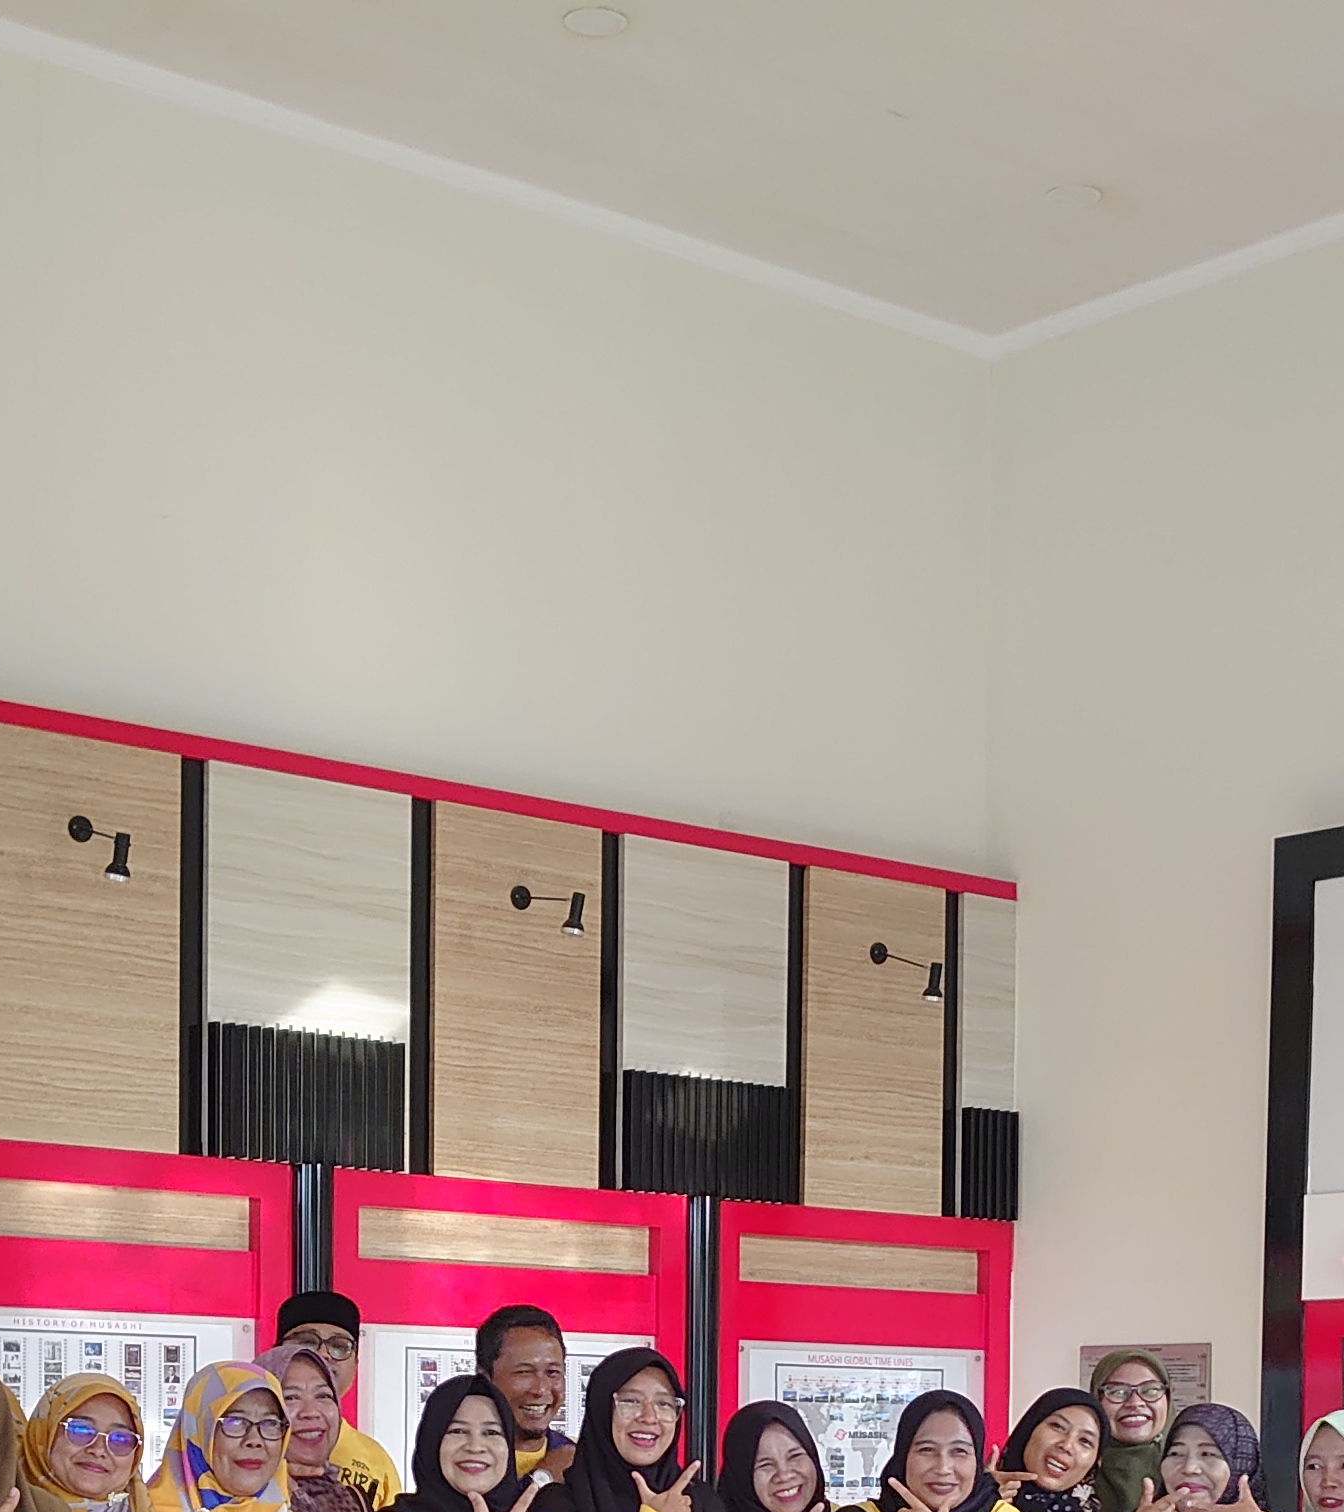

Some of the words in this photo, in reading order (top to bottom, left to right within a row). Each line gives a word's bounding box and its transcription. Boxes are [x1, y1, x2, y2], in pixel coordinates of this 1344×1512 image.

[13, 1318, 67, 1327] HISTORY
[70, 1319, 85, 1328] OF
[89, 1321, 143, 1331] MUSASHI
[807, 1354, 843, 1364] MUSASHI
[844, 1355, 873, 1365] GLOBAL
[874, 1357, 893, 1366] TIME
[893, 1357, 914, 1367] LINES
